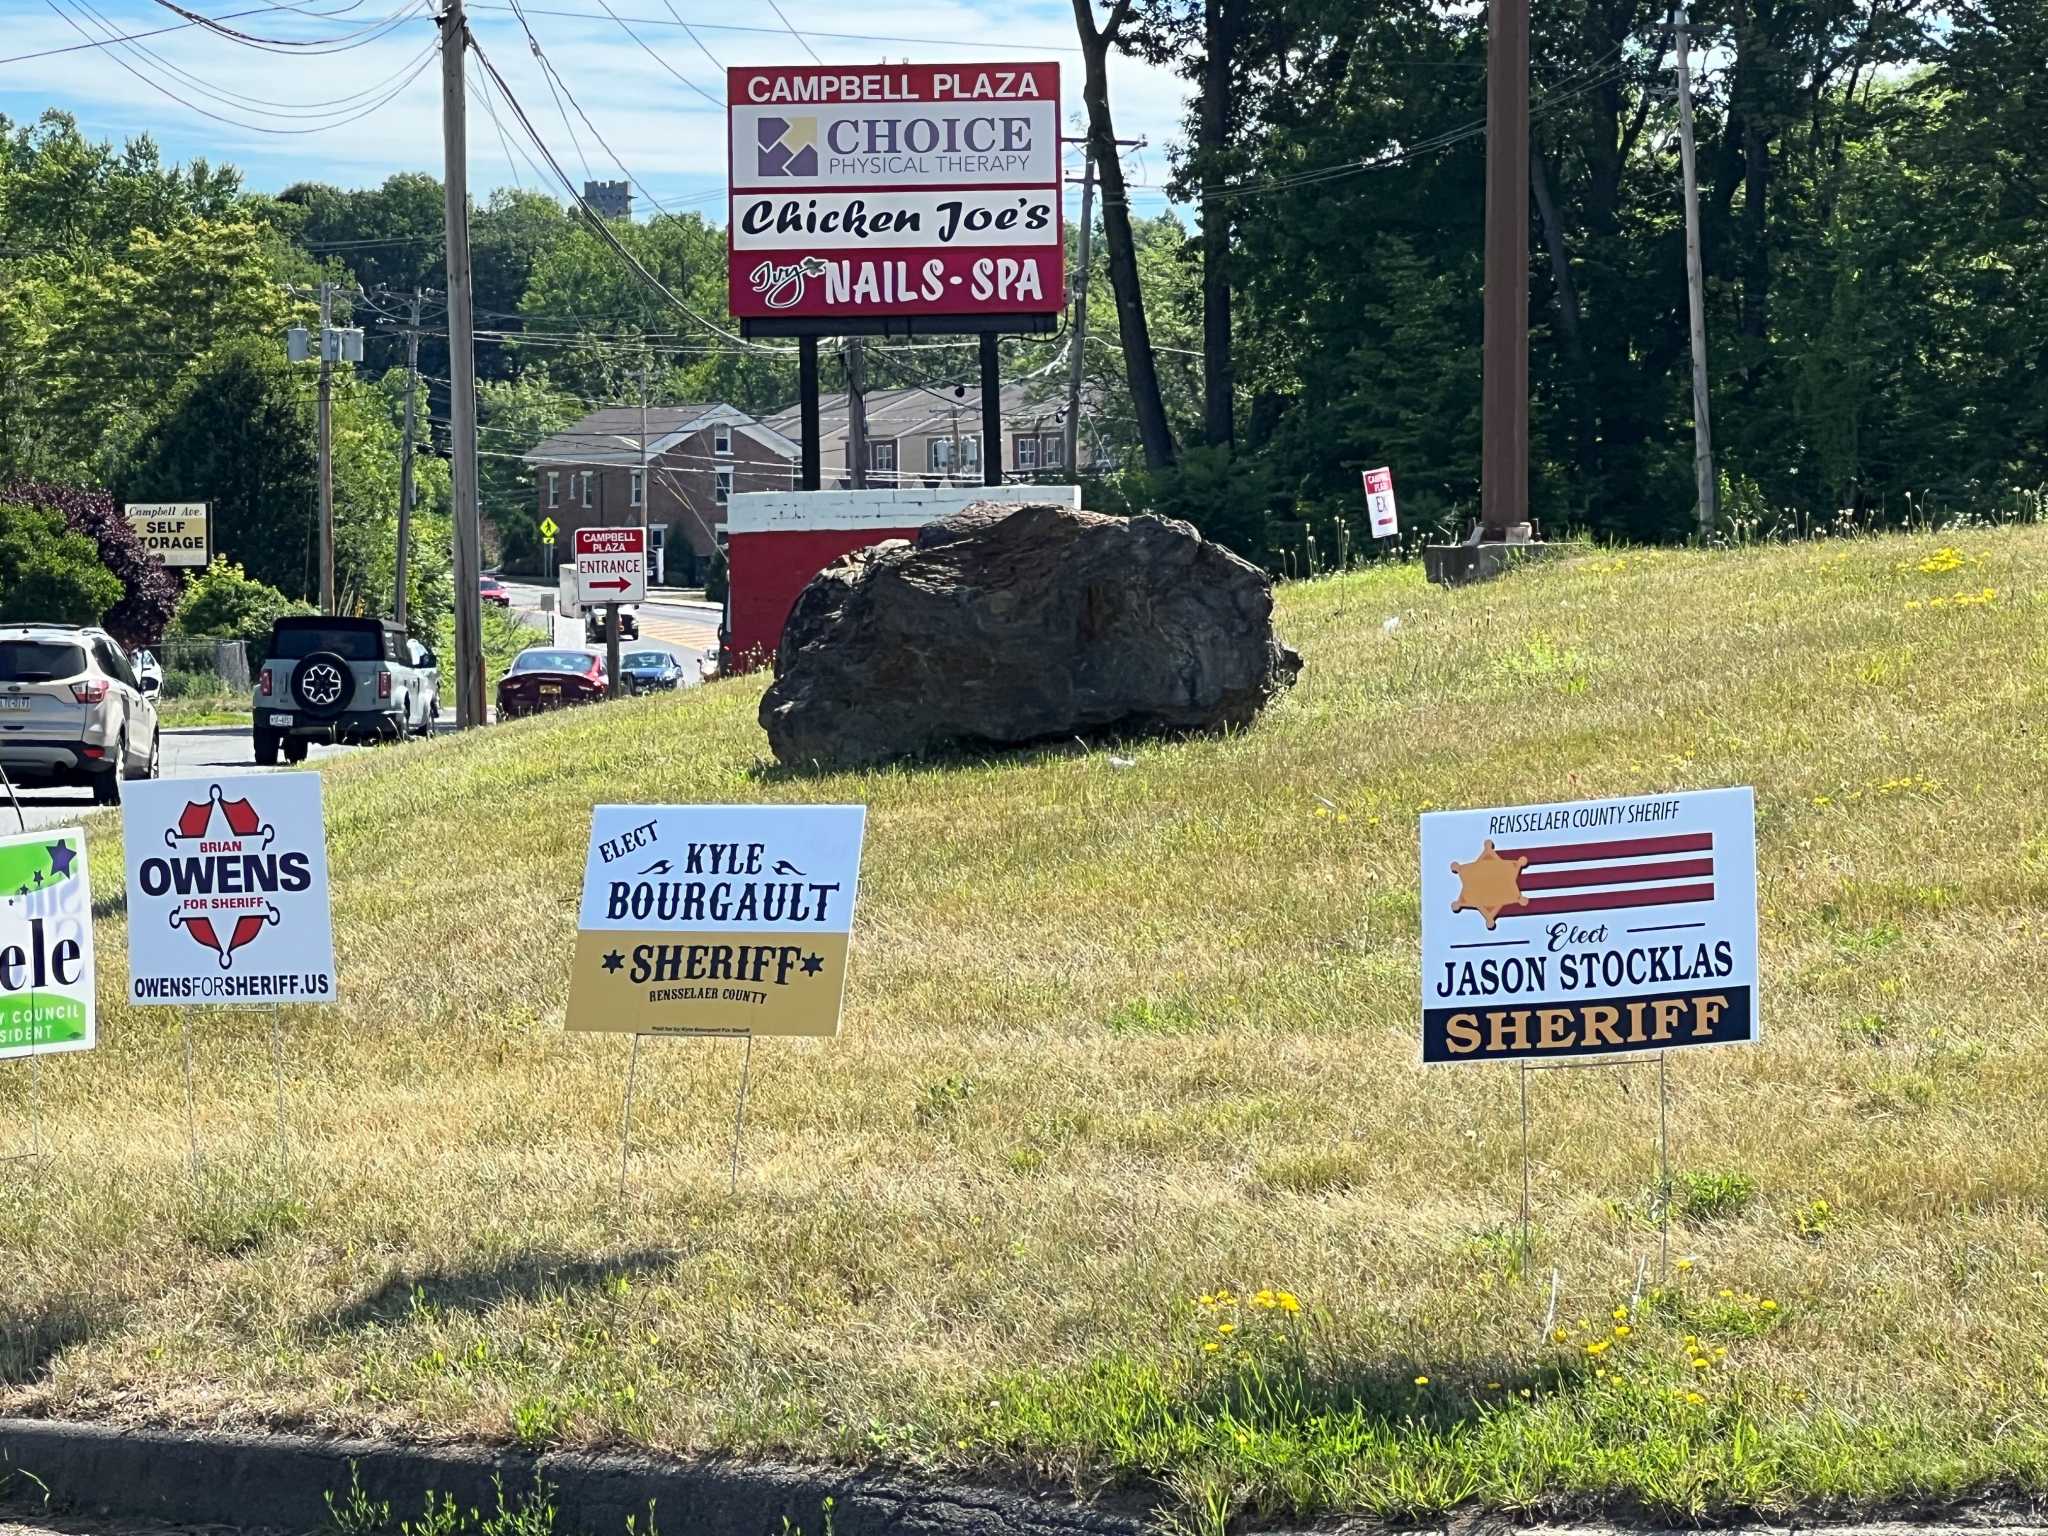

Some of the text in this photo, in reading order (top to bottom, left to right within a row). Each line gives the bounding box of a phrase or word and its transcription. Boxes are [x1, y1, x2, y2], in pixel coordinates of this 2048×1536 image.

[748, 72, 1039, 103] CAMPBELL PLAZA
[827, 117, 1032, 155] CHOICE
[829, 154, 1030, 175] PHYSICAL THERAPY
[741, 198, 1050, 242] Chicken Joe's
[749, 261, 804, 308] Ivy
[825, 259, 945, 304] NAILS
[971, 258, 1043, 301] SPA
[129, 506, 176, 518] Campbell
[138, 536, 204, 549] TORAGE
[146, 521, 185, 534] SELF
[583, 532, 637, 543] CAMPBELL
[593, 542, 626, 552] PLAZA
[580, 559, 641, 573] ENTRANCE
[1489, 800, 1680, 835] RENSSELAER COUNTY SHERIFF
[200, 841, 242, 853] BRIAN
[598, 819, 660, 864] ELECT
[139, 852, 312, 896] OWENS
[685, 843, 765, 875] KYLE
[184, 897, 264, 910] FOR SHERIFF
[606, 881, 840, 922] BOURGAULT
[1546, 922, 1609, 952] Elect
[630, 944, 802, 985] SHERIFF
[1436, 940, 1733, 998] JASON STOCKLAS
[135, 974, 329, 998] OWENSFORSHERIFF.US
[649, 987, 767, 1004] RENSSELAER COUNTY
[12, 1006, 79, 1021] COUNCIL
[1445, 994, 1730, 1055] SHERIFF
